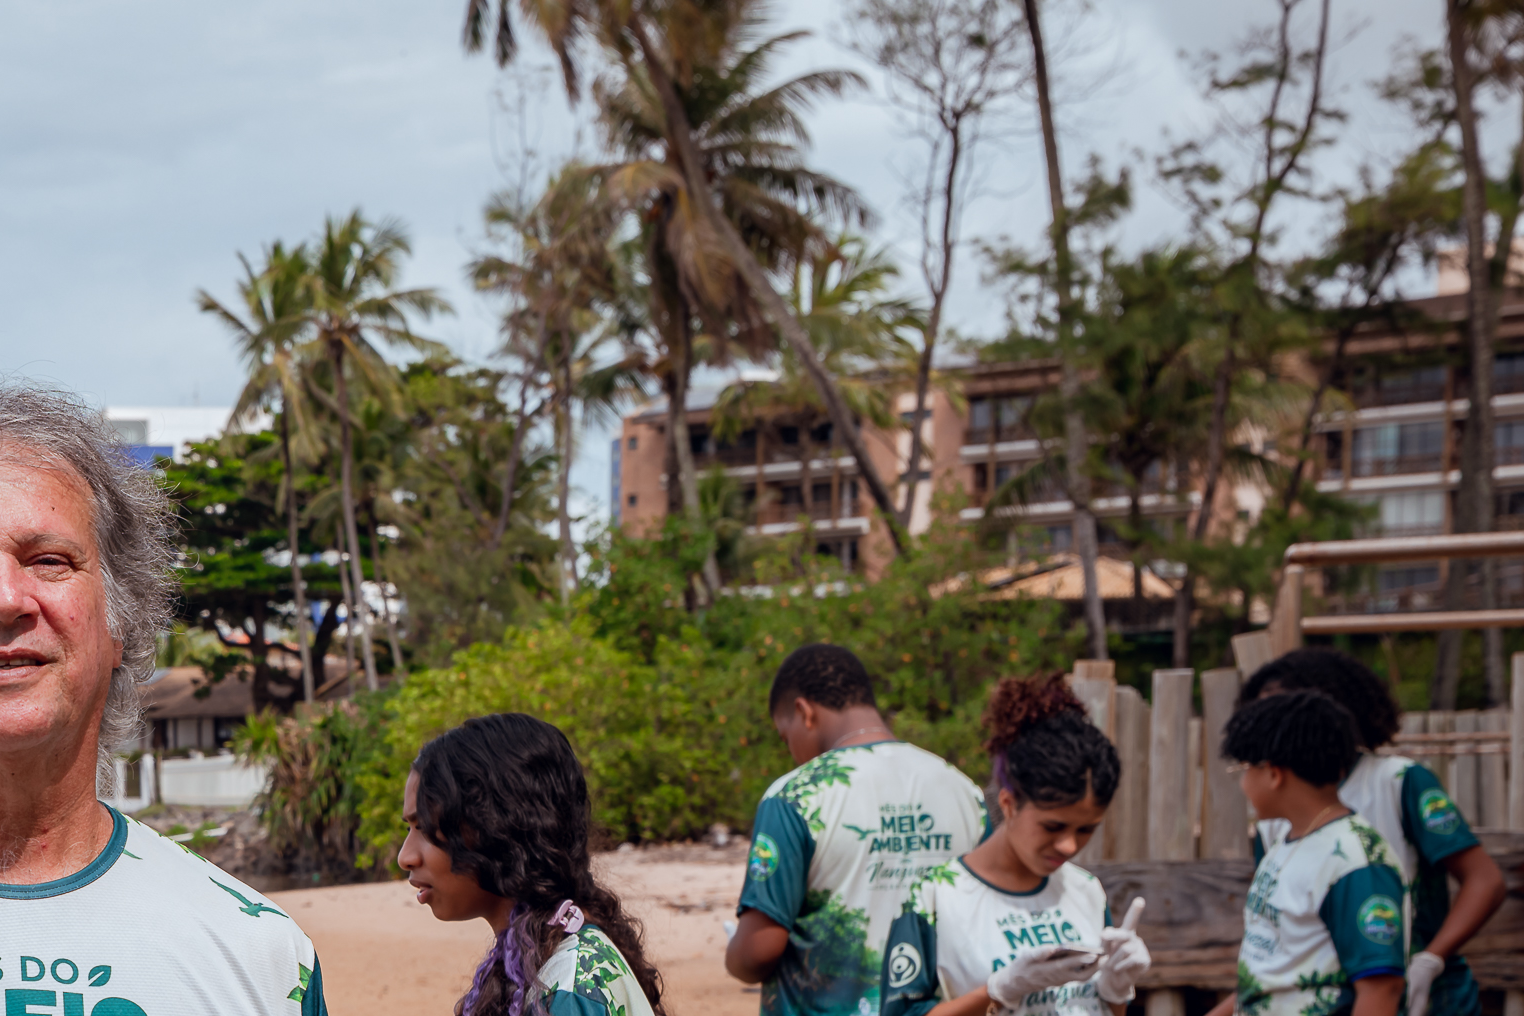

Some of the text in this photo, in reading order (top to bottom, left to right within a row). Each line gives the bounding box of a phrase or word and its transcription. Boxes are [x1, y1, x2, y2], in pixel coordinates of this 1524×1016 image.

[881, 813, 935, 834] MEIO
[869, 834, 953, 855] AMBIENTE
[1003, 921, 1082, 950] MEIO
[20, 955, 80, 985] DO
